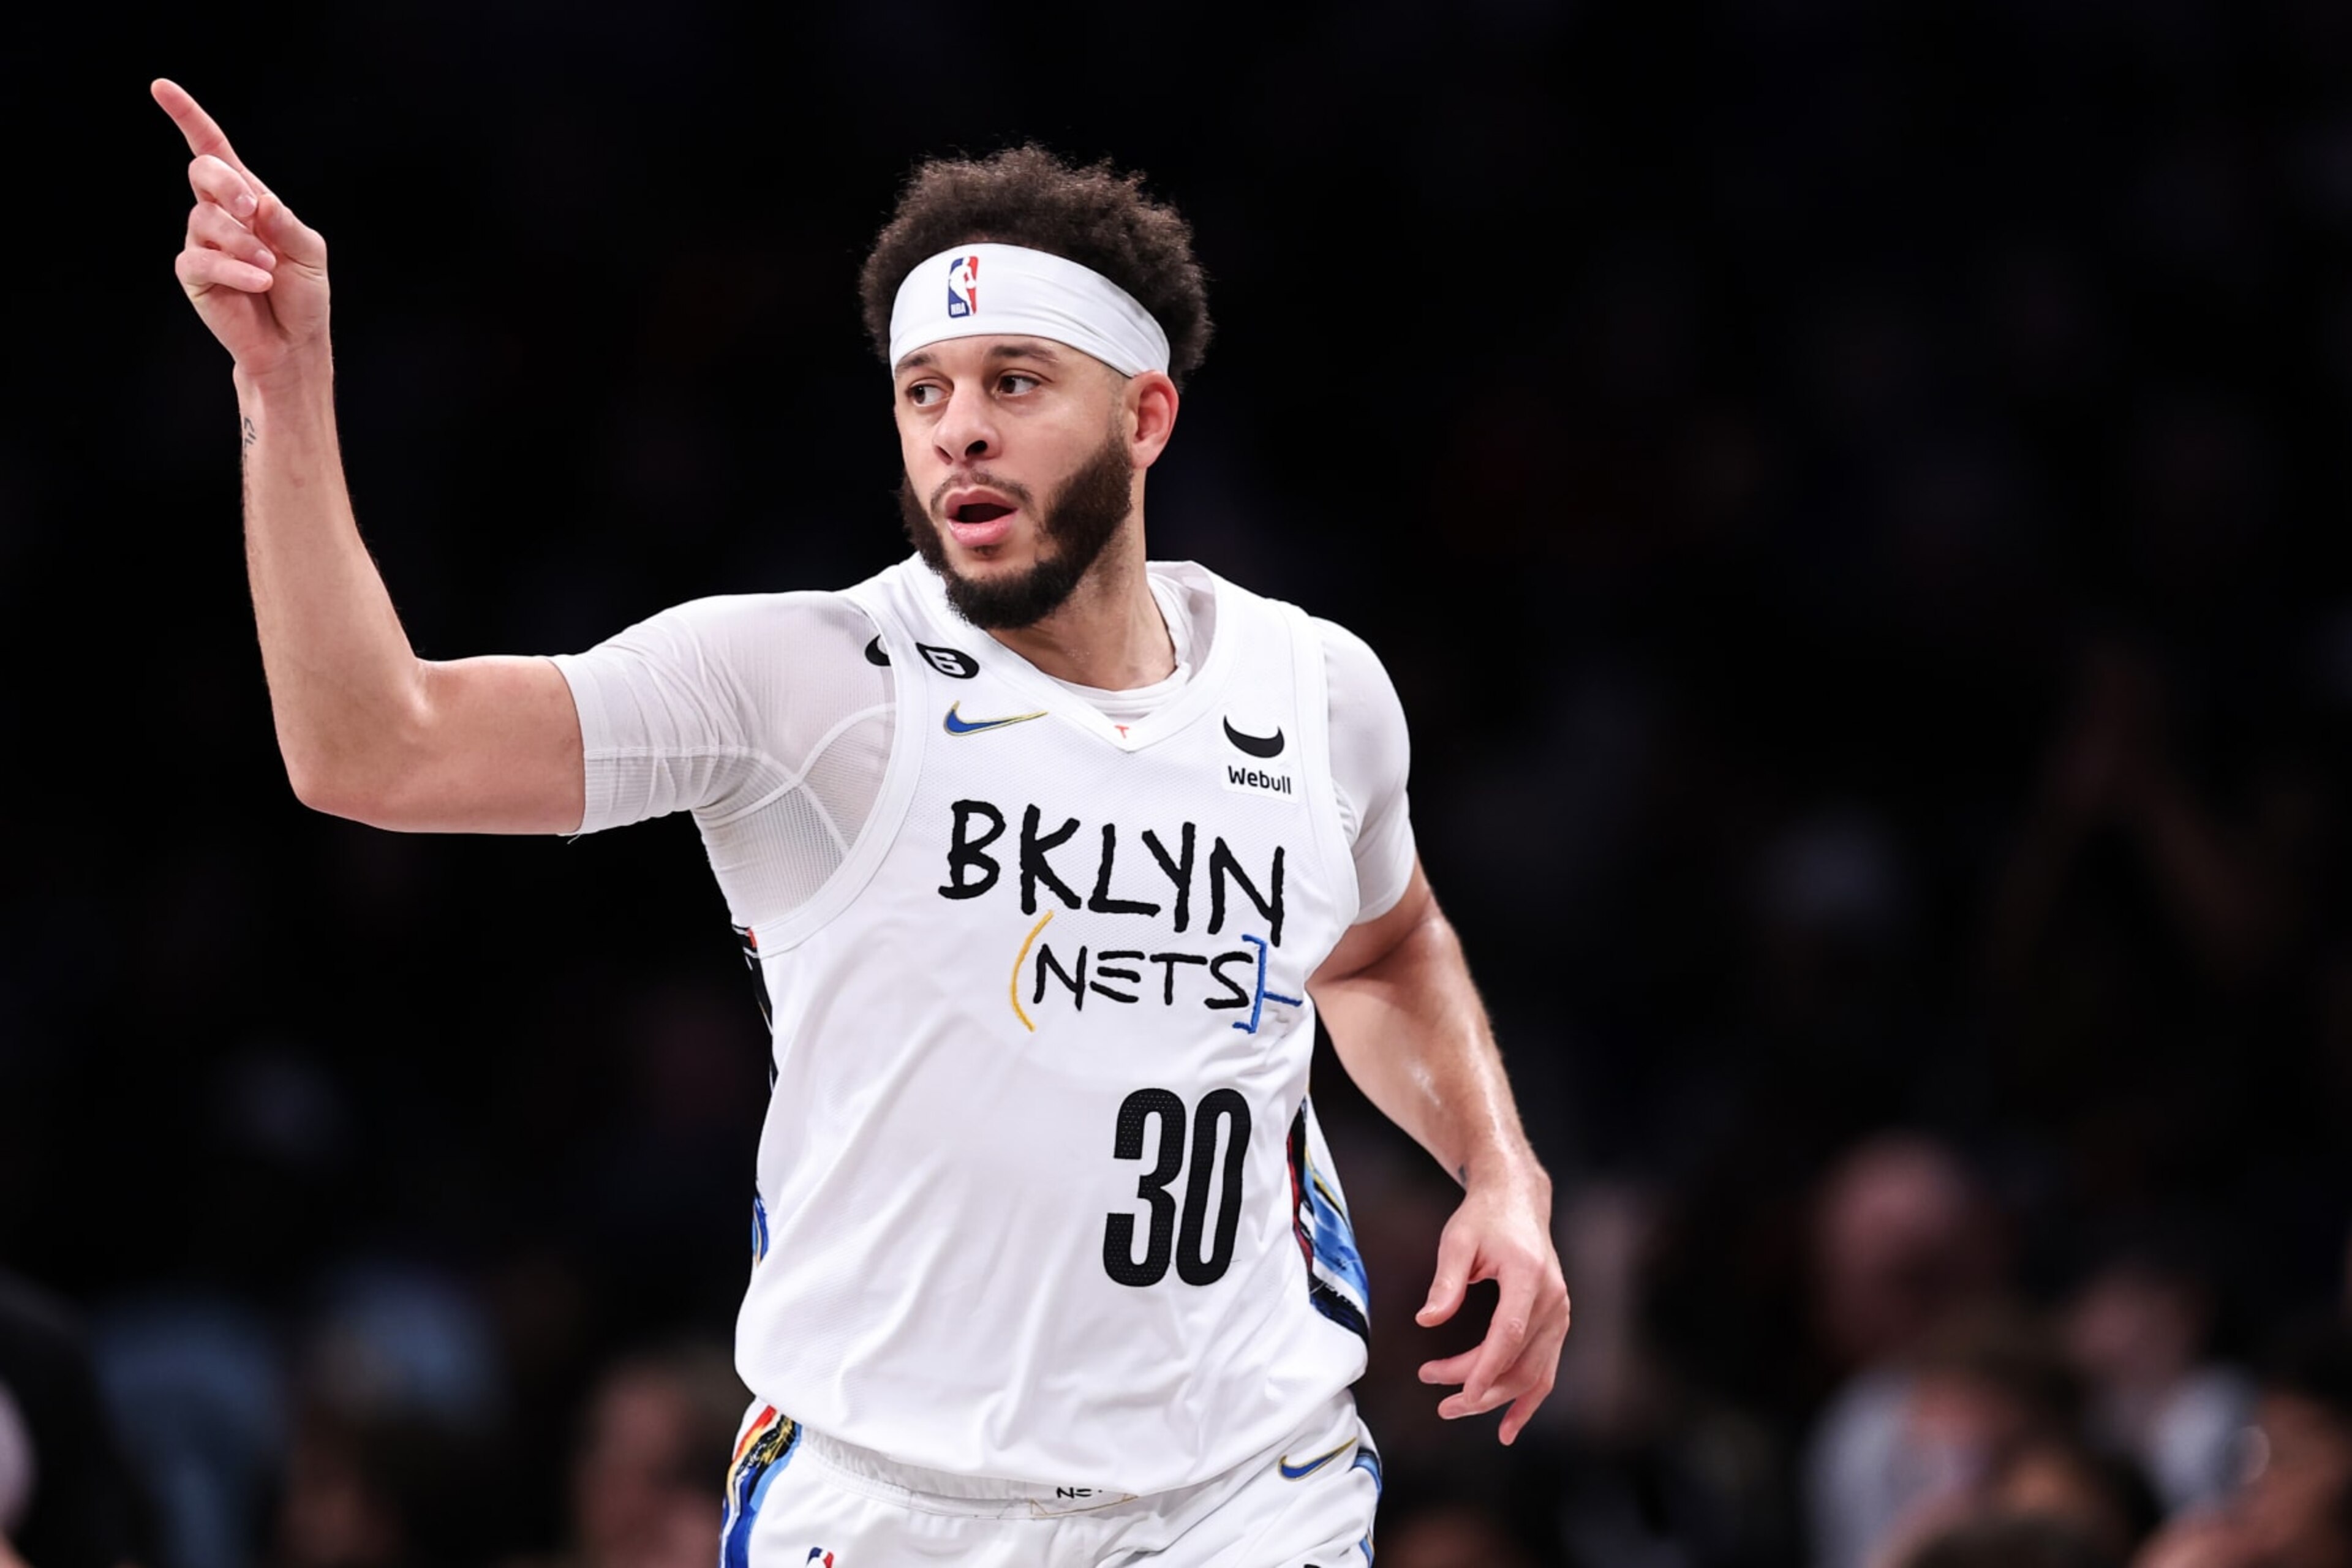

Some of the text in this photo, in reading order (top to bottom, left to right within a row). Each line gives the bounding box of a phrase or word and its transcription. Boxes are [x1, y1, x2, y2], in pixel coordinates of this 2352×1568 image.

[1227, 765, 1291, 794] Webull
[938, 799, 1284, 947] BKLYN
[1103, 1088, 1251, 1287] 30
